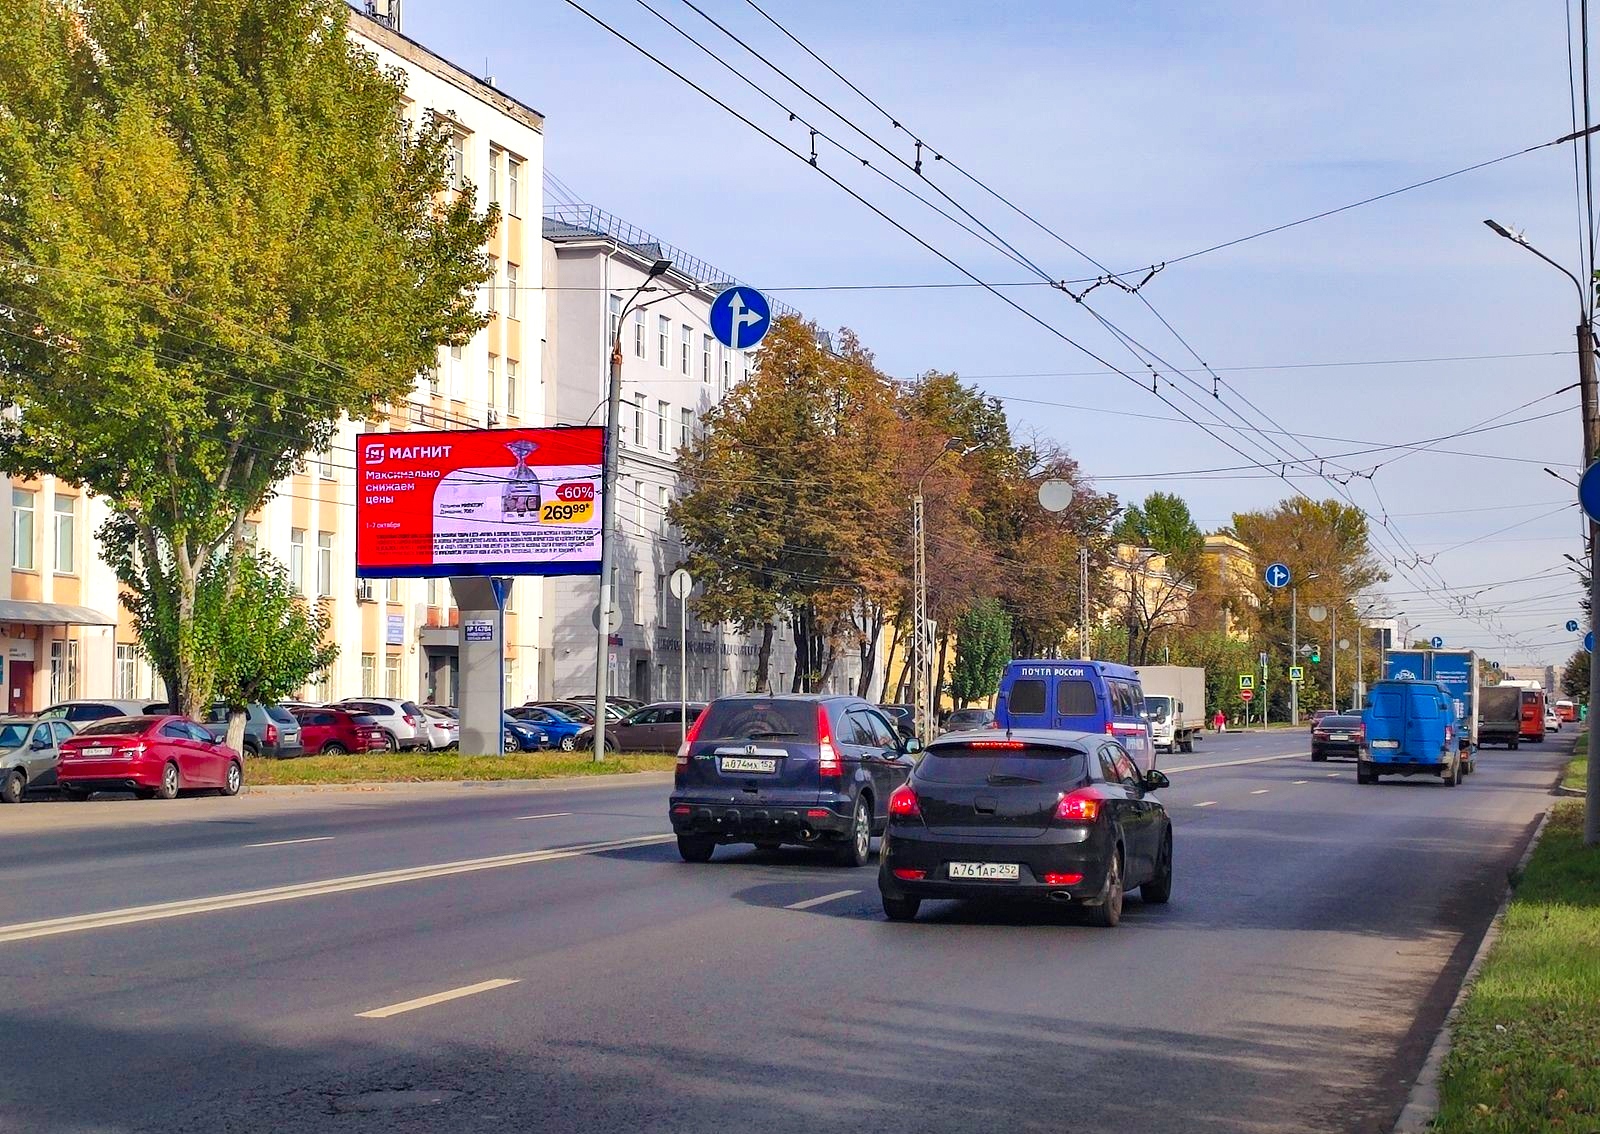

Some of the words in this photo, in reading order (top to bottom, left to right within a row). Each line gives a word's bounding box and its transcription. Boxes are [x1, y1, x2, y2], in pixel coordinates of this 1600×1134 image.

[389, 445, 452, 459] МАГНИТ
[365, 470, 441, 480] Максимально
[365, 483, 415, 492] снижаем
[365, 495, 394, 504] цены
[1022, 668, 1052, 676] ПОЧТА
[1054, 668, 1084, 676] РОССИИ
[952, 864, 997, 877] А761АР
[999, 864, 1017, 875] 252
